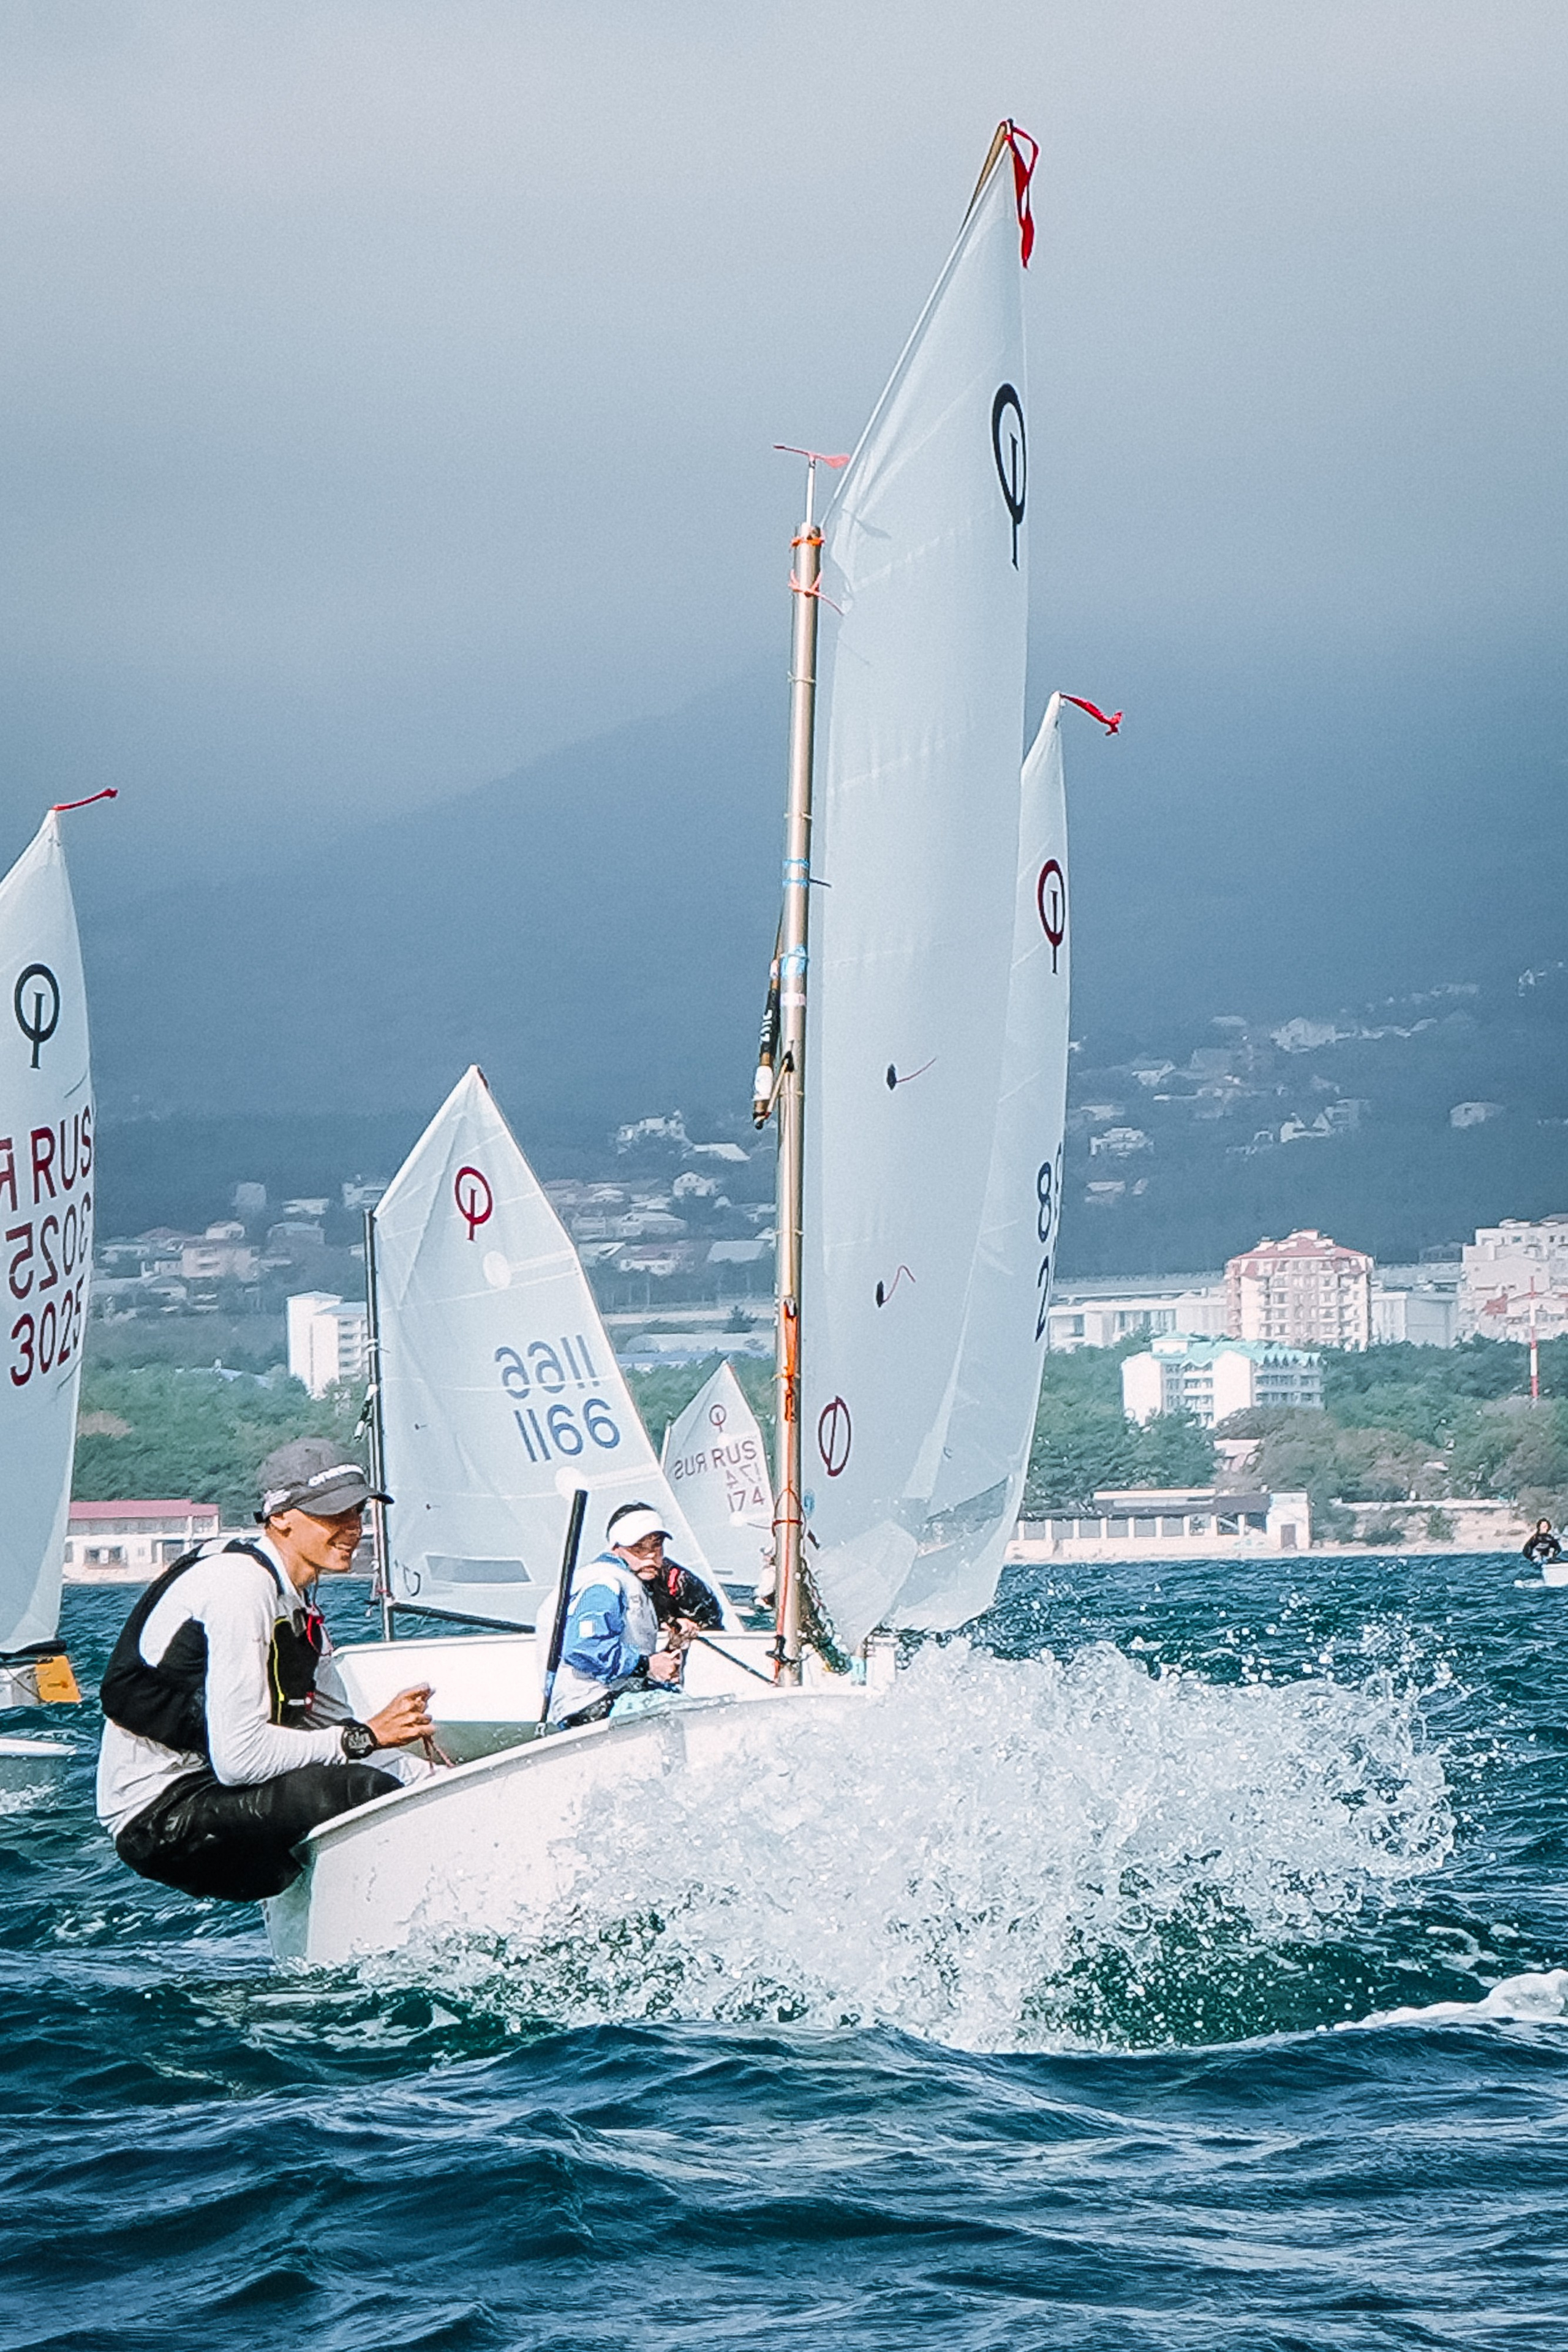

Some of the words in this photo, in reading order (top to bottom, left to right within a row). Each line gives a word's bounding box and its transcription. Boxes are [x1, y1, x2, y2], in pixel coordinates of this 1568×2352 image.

[31, 1105, 92, 1205] RUS
[10, 1273, 85, 1387] 3025
[513, 1398, 620, 1463] 1166
[711, 1441, 757, 1469] RUS
[727, 1486, 766, 1512] 174
